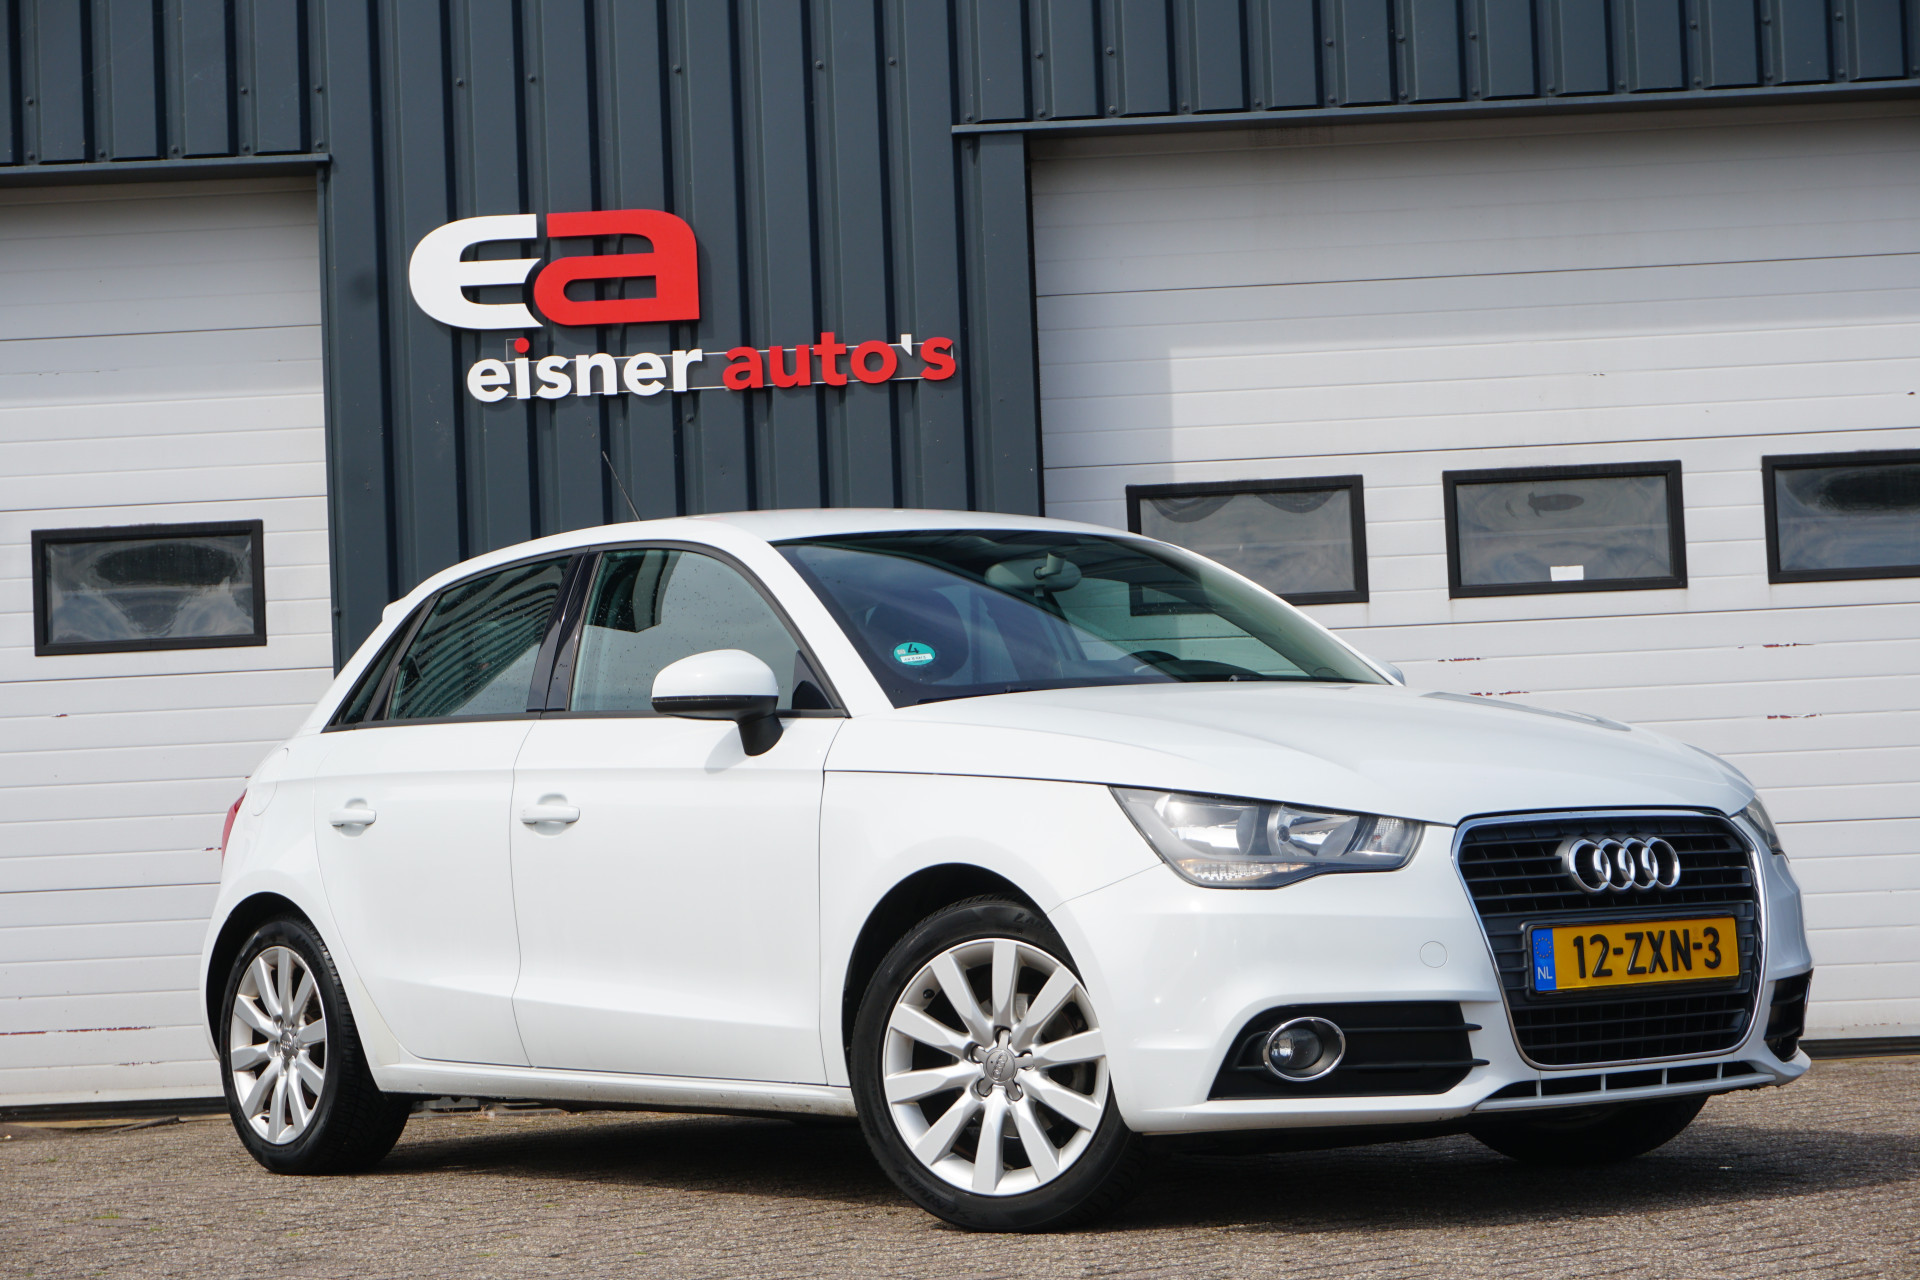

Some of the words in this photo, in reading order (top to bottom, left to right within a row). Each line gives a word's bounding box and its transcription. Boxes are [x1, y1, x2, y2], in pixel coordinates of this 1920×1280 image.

[466, 337, 703, 402] eisner
[722, 331, 957, 391] auto's
[1537, 966, 1553, 980] NL
[1573, 926, 1722, 979] 12-ZXN-3
